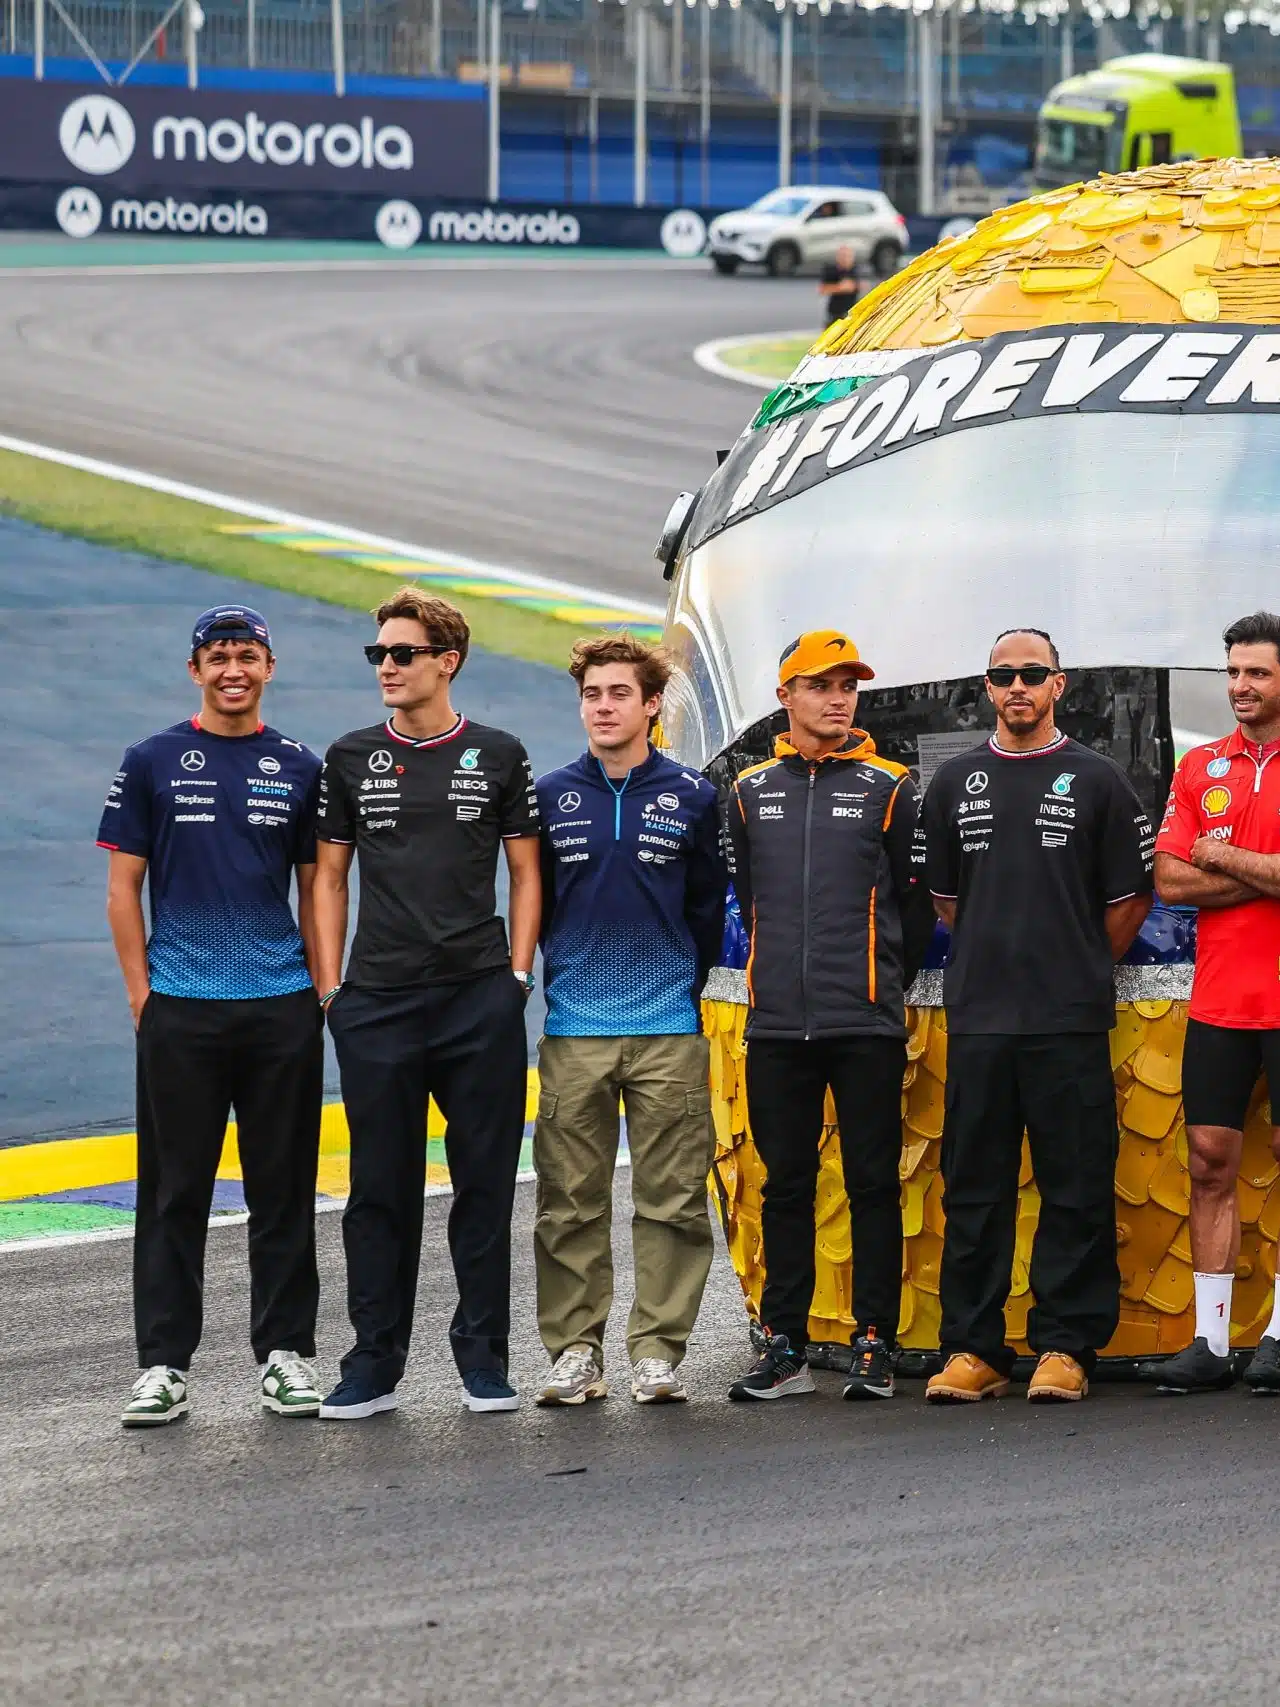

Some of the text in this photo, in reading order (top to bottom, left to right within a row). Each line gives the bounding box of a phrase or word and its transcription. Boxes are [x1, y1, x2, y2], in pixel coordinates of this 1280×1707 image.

[153, 111, 413, 170] motorola
[111, 197, 268, 235] motorola
[429, 209, 580, 244] motorola
[247, 778, 293, 791] WILLIAMS
[374, 779, 398, 789] UBS
[451, 780, 488, 791] INEOS
[251, 786, 288, 796] RACING
[174, 794, 215, 805] Stephens
[247, 798, 292, 811] DURACELL
[969, 799, 991, 811] UBS
[1044, 794, 1075, 803] PETRONAS
[759, 805, 785, 815] DELL
[1039, 803, 1077, 818] INEOS
[641, 812, 688, 831] WILLIAMS
[645, 820, 682, 836] RACING
[552, 837, 588, 849] Stephens
[1216, 1302, 1225, 1318] 1
